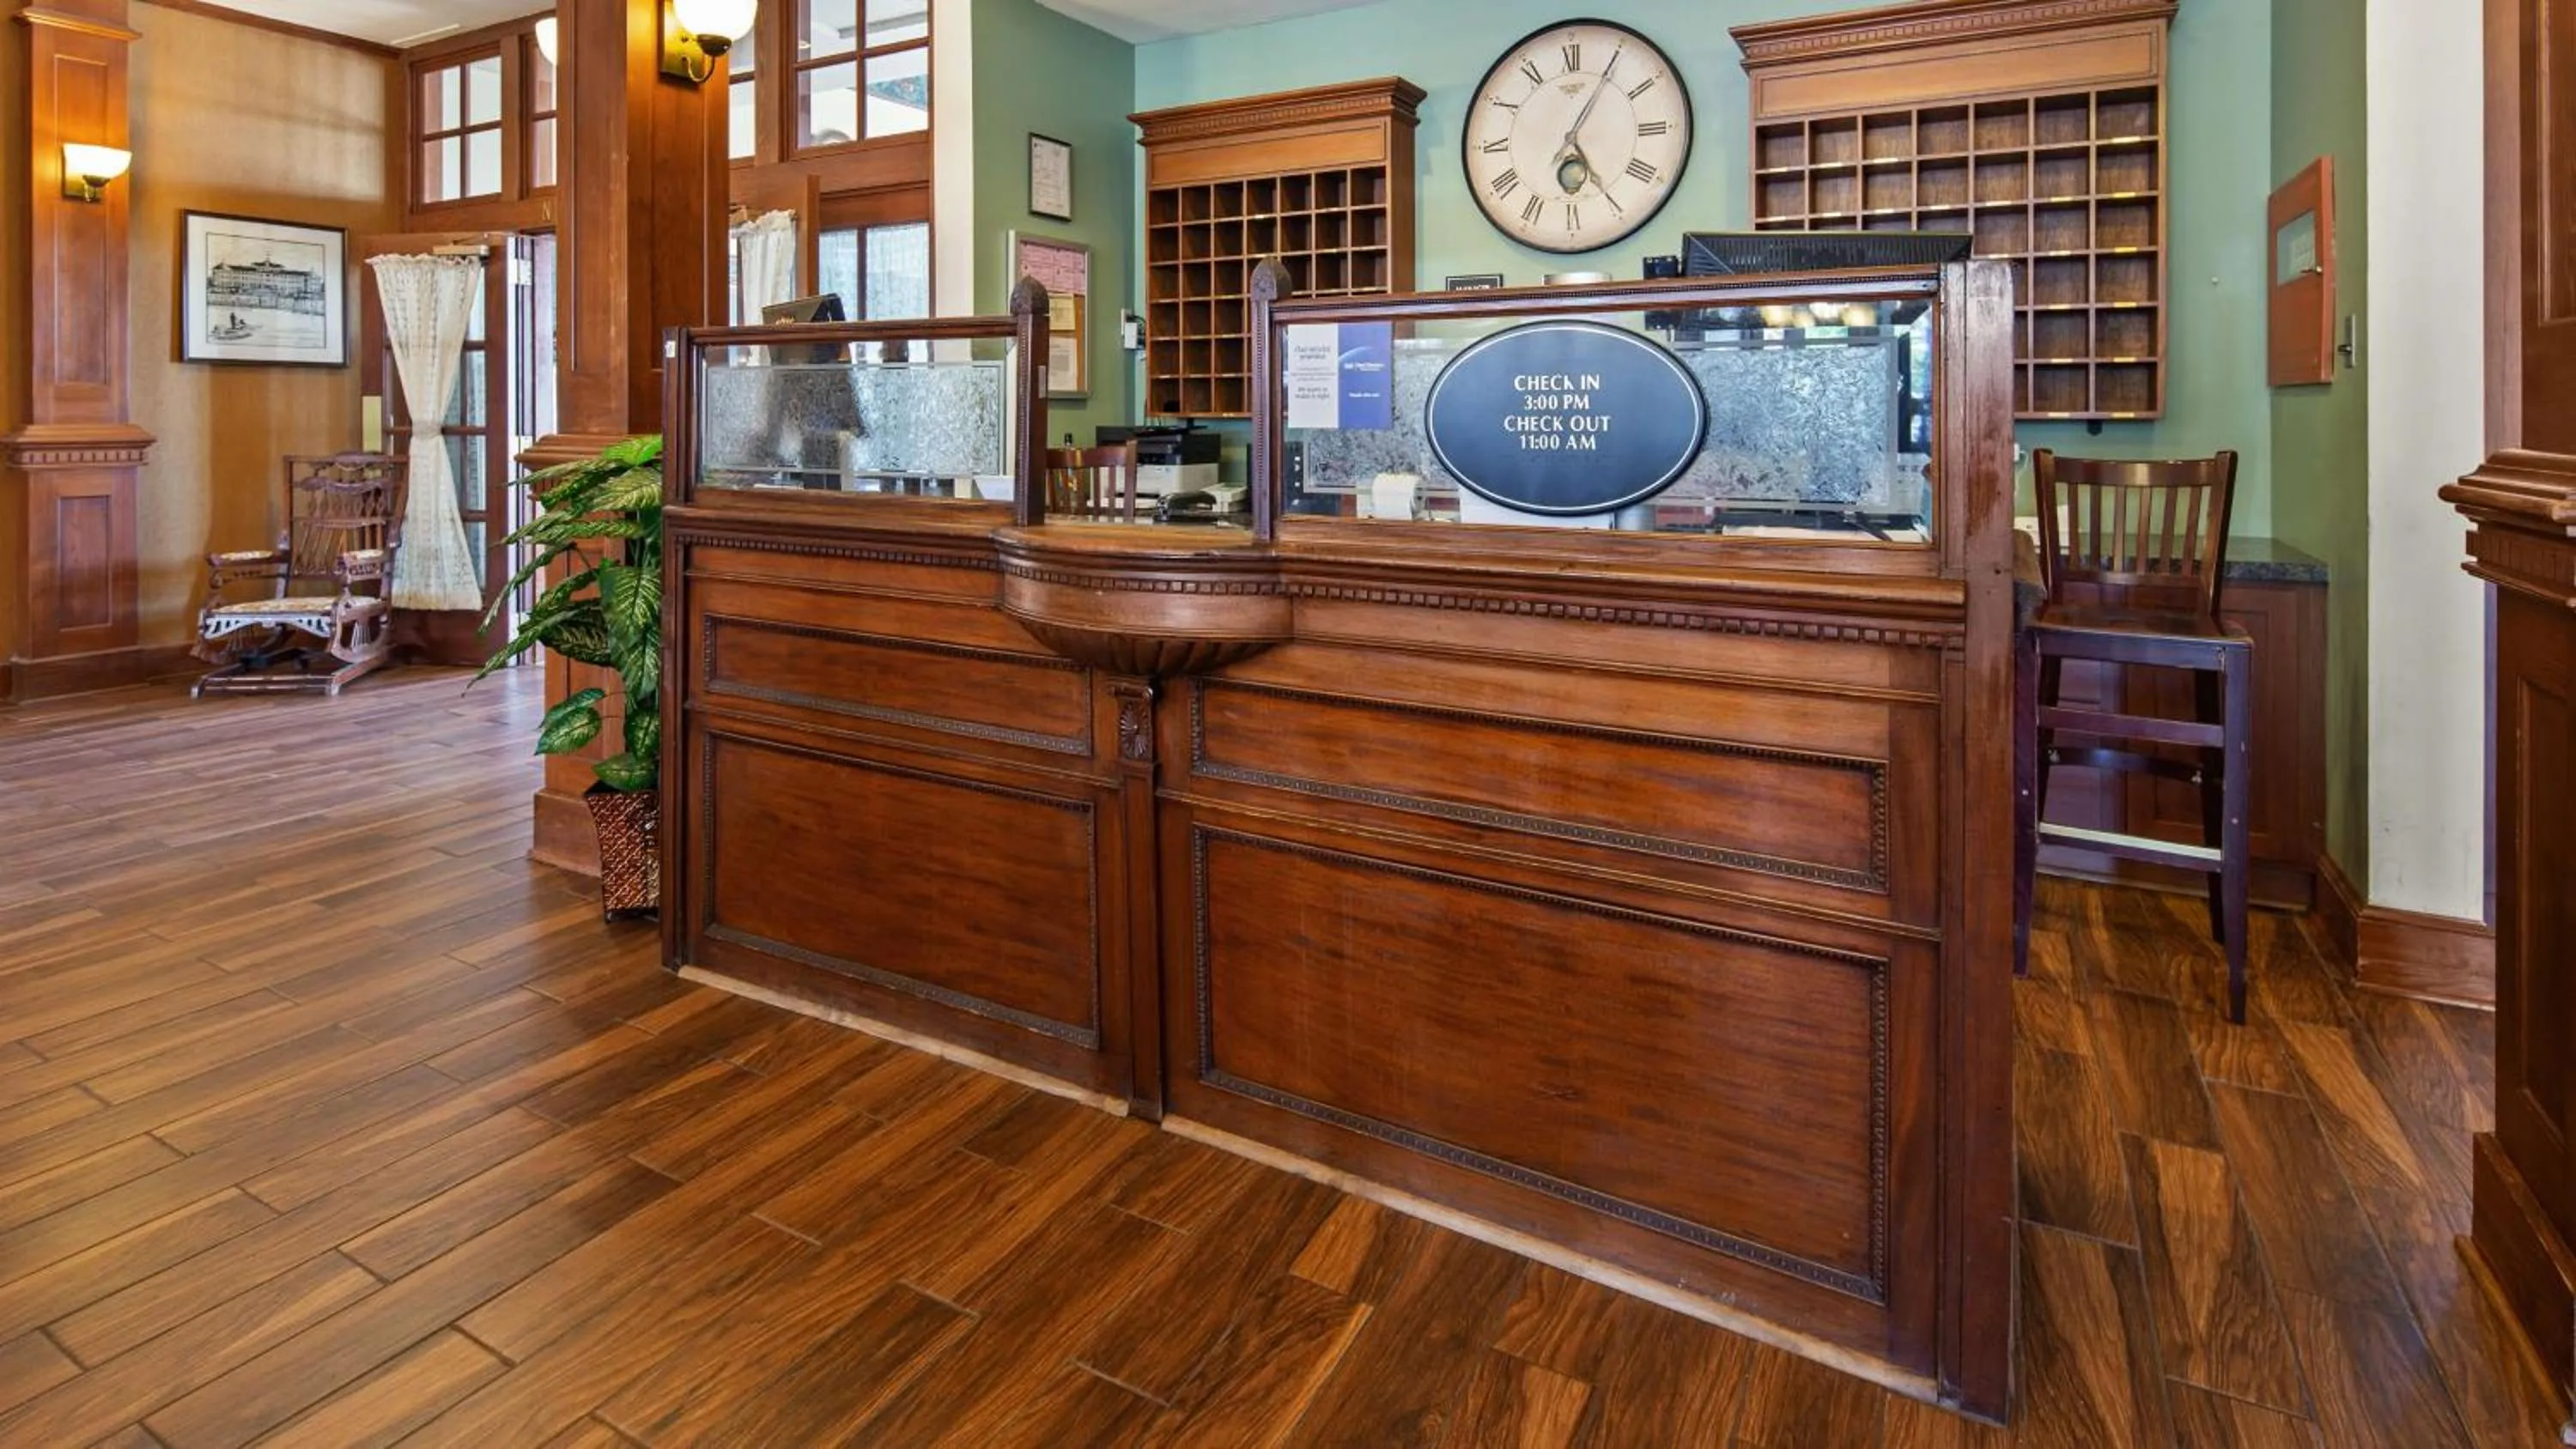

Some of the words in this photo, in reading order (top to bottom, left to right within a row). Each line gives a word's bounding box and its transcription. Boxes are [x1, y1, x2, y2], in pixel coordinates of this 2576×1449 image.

[1514, 373, 1575, 391] CHECK
[1581, 373, 1601, 391] IN
[1524, 394, 1558, 410] 3:00
[1563, 394, 1590, 409] PM
[1504, 415, 1564, 432] CHECK
[1570, 415, 1612, 432] OUT
[1520, 433, 1560, 450] 11:00
[1565, 433, 1597, 451] AM
